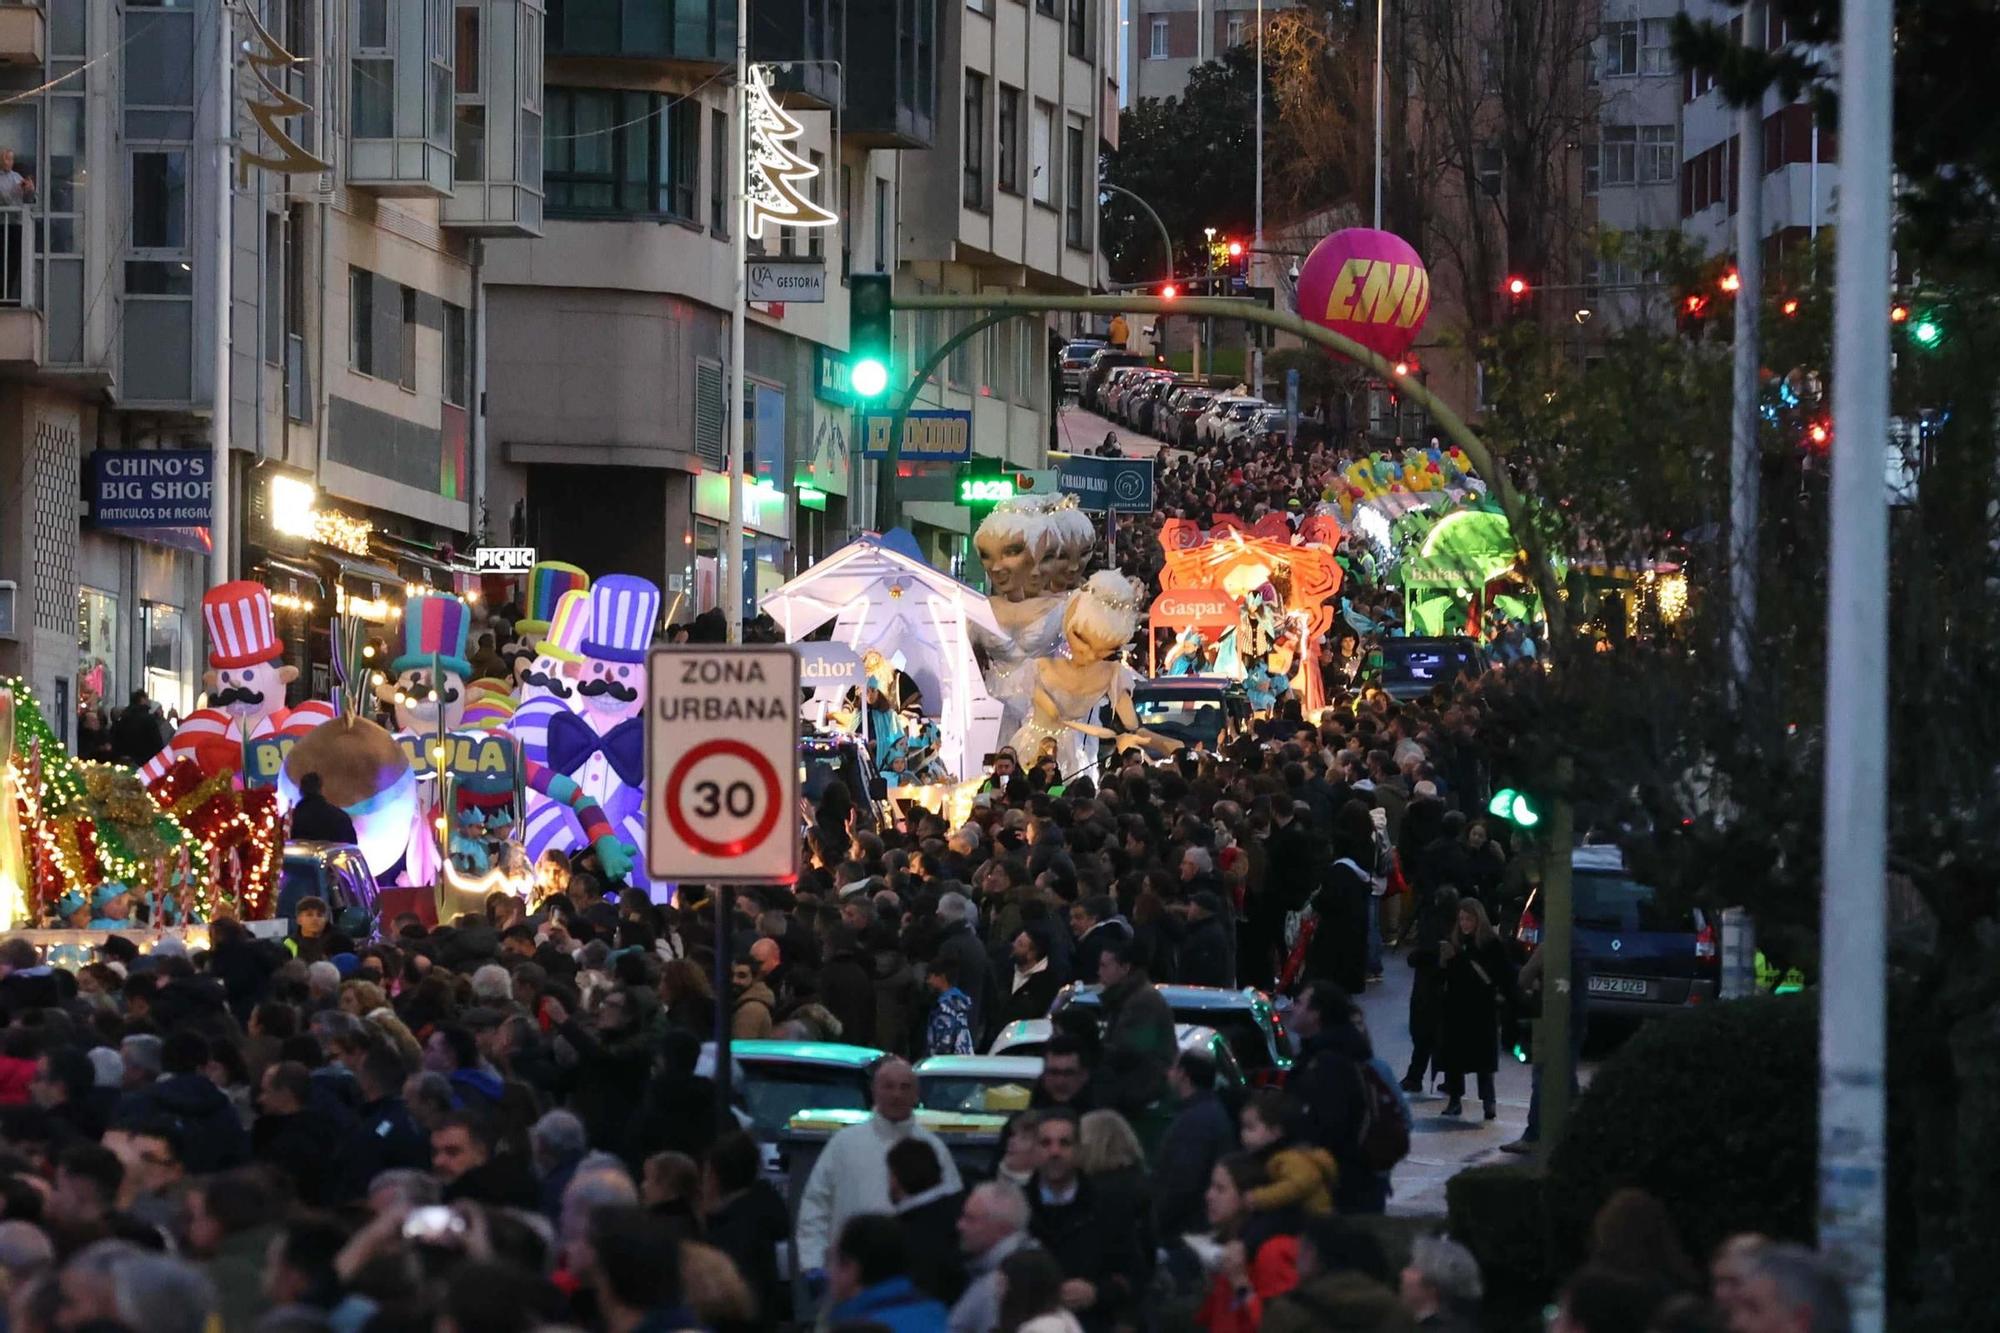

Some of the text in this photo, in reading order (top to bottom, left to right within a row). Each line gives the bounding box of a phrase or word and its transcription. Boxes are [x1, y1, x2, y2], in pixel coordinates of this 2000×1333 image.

[777, 277, 819, 288] GESTORIA
[105, 458, 204, 476] CHINO'S
[102, 481, 143, 499] BIG
[158, 507, 172, 519] DE
[479, 550, 532, 566] PICNIC
[1160, 598, 1226, 620] Gaspar
[680, 659, 766, 684] ZONA
[801, 656, 856, 678] lchor
[660, 697, 787, 721] URBANA
[693, 780, 755, 819] 30
